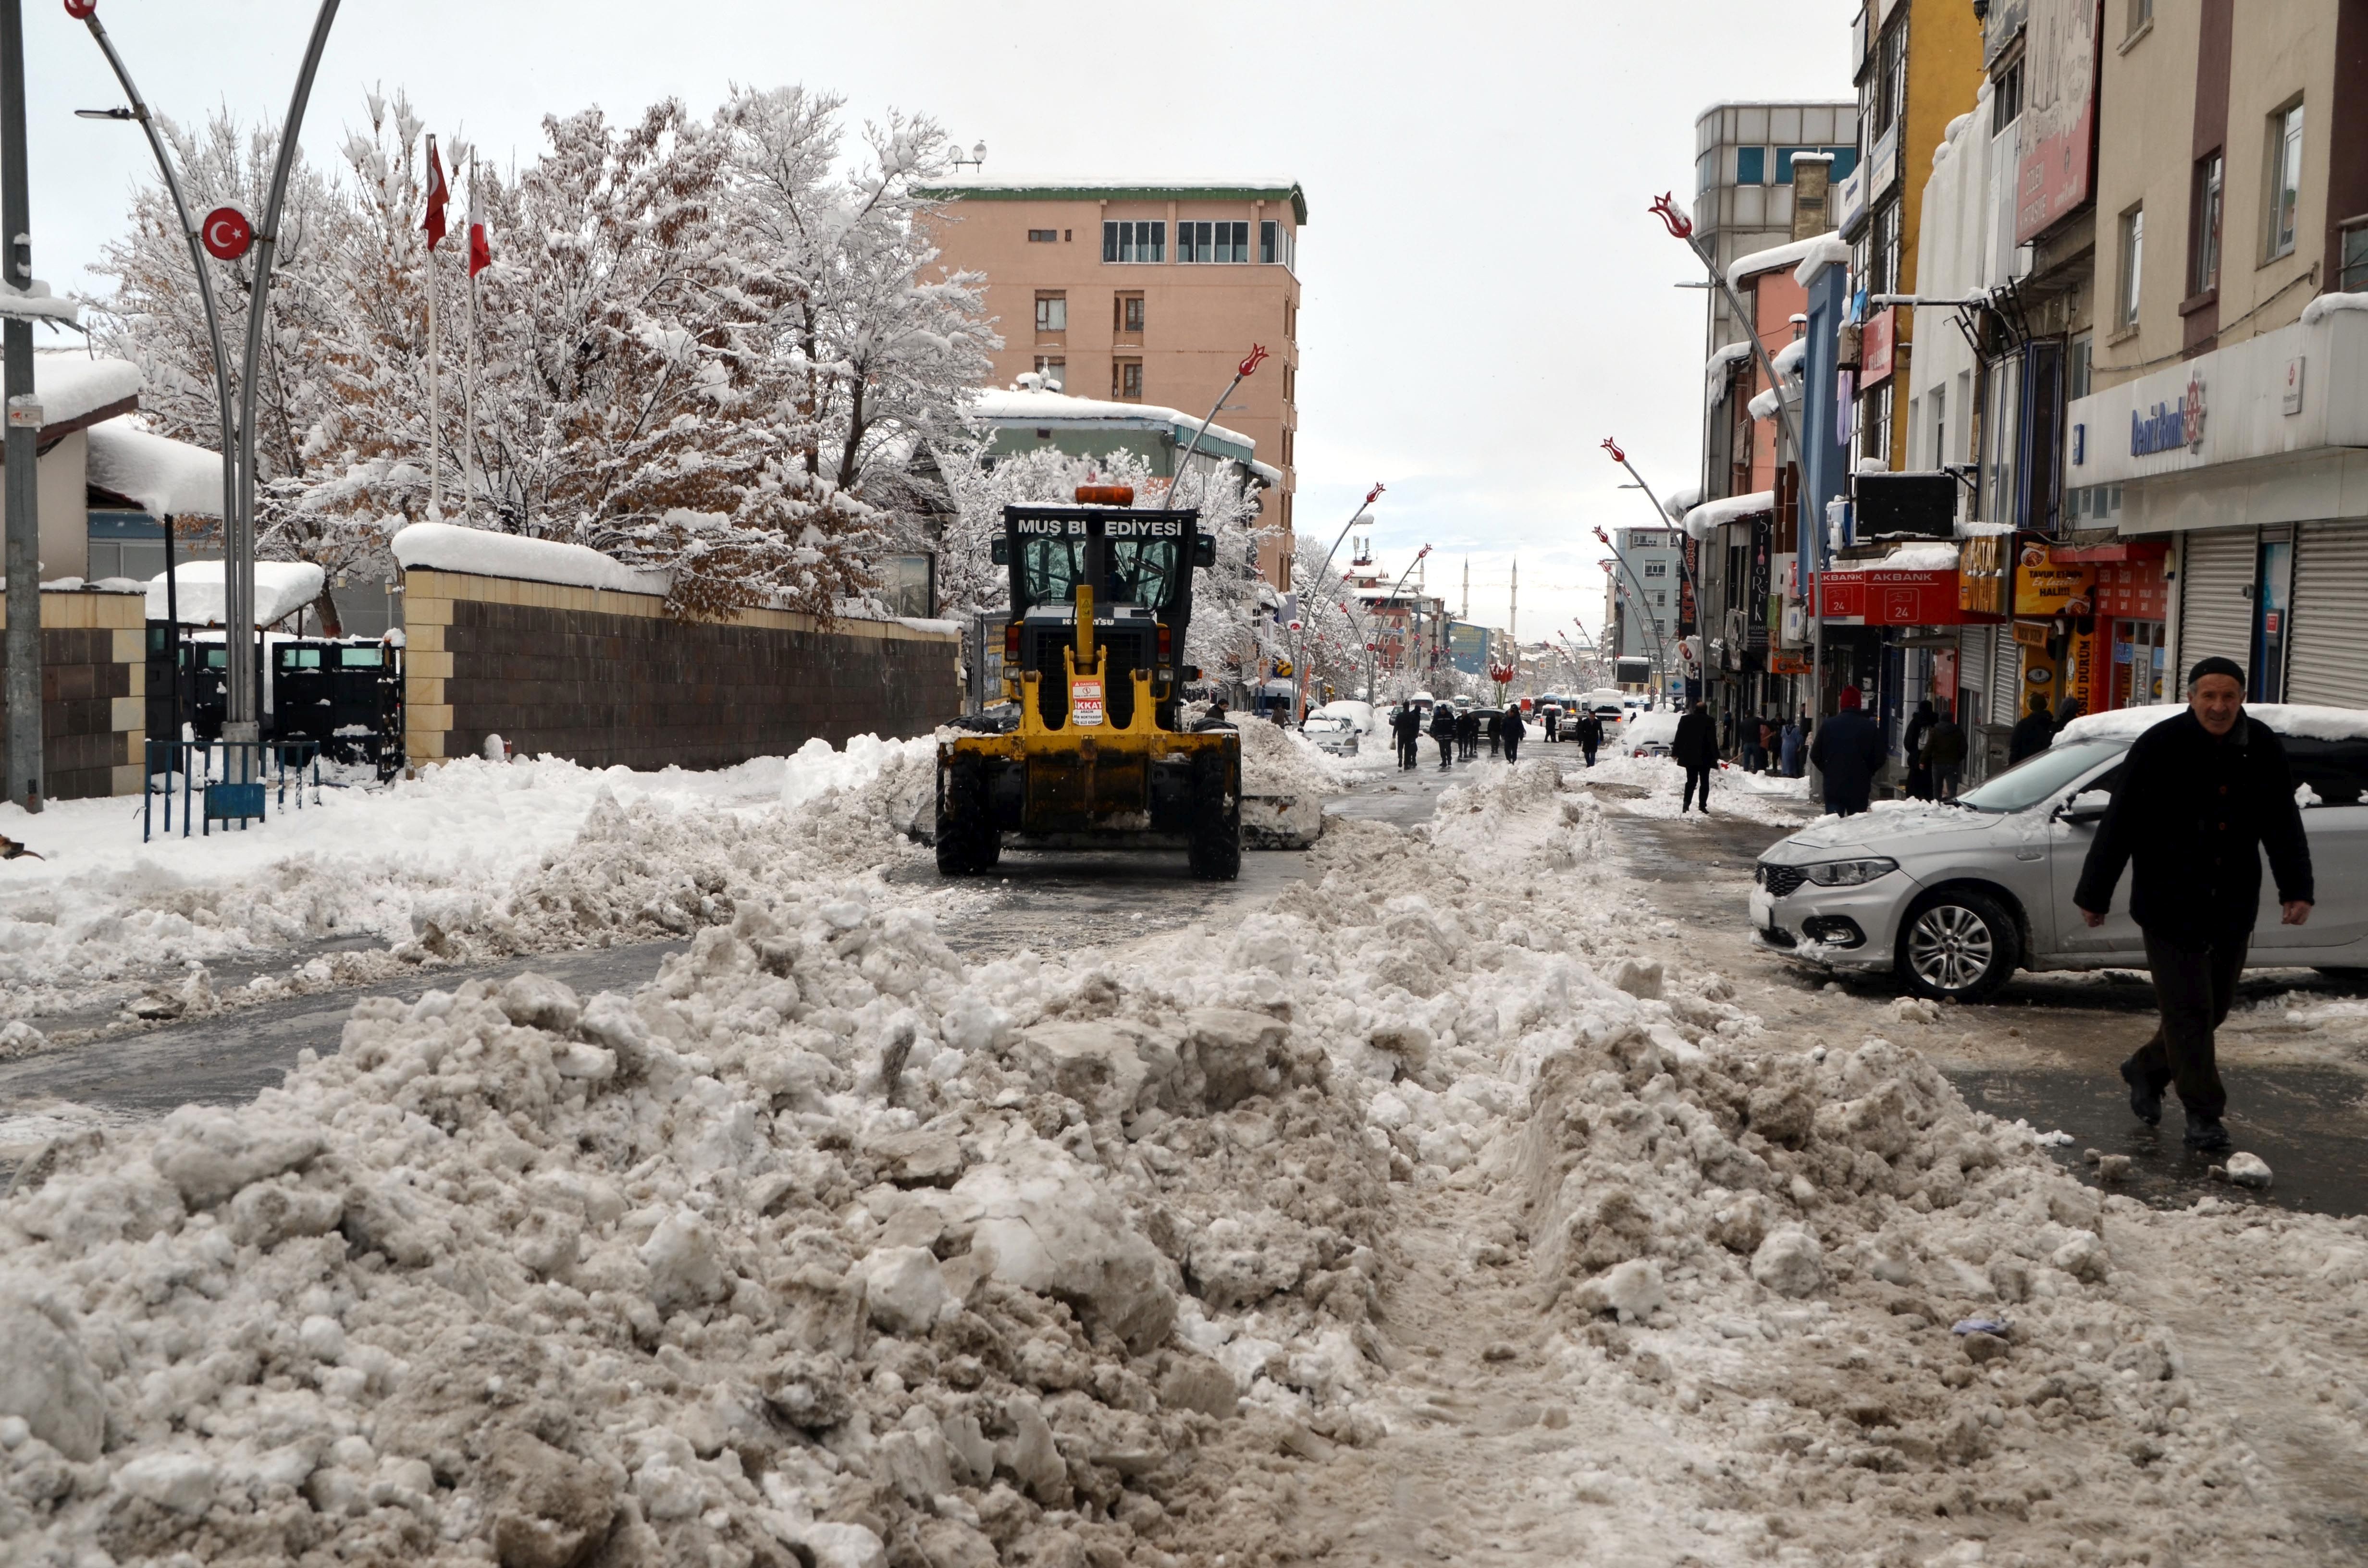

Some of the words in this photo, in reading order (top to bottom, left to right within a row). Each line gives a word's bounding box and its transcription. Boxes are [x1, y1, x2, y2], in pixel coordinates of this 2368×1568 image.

[2131, 396, 2184, 456] DenizBank
[1018, 520, 1061, 536] MUŞ
[1068, 519, 1182, 536] BEDİYESİ
[1873, 573, 1932, 581] AKBANK
[1834, 602, 1844, 611] 24
[1895, 607, 1909, 618] 24
[1062, 617, 1114, 625] KOTSU
